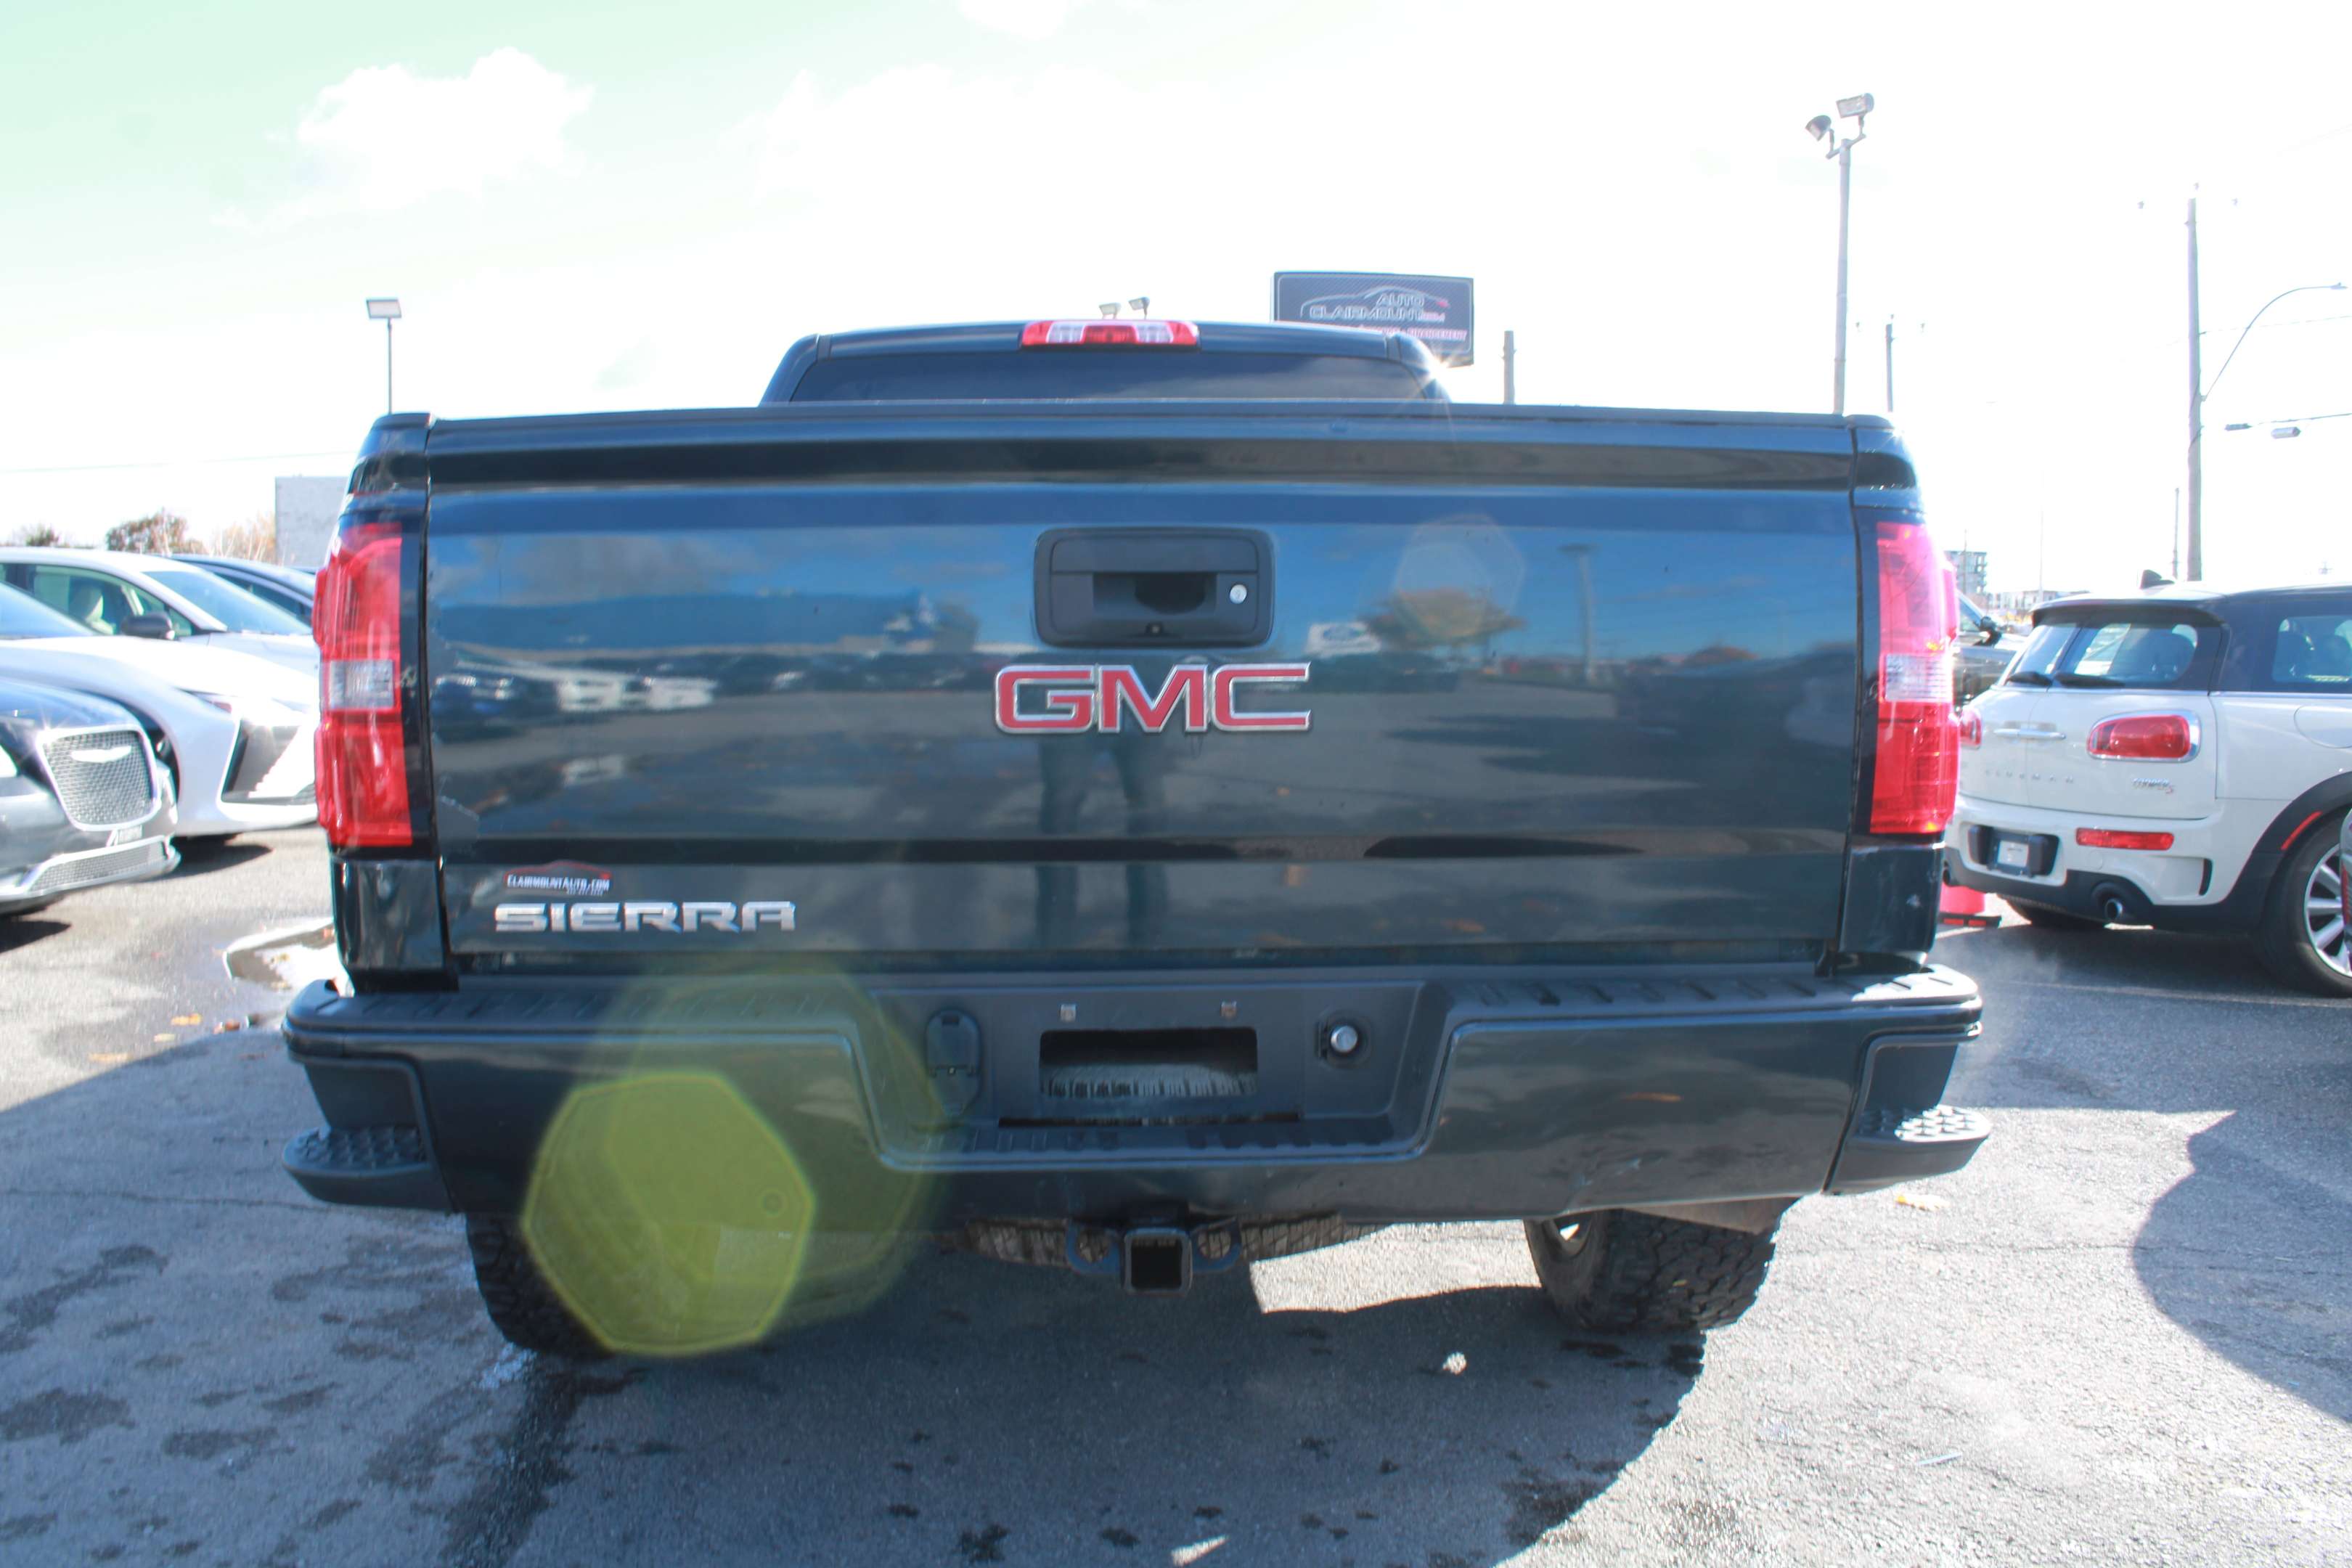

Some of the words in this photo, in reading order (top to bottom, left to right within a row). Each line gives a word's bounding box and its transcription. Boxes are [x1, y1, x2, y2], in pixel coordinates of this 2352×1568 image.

[1376, 293, 1424, 307] AUTO
[995, 662, 1311, 732] GMC
[495, 902, 796, 934] SIERRA
